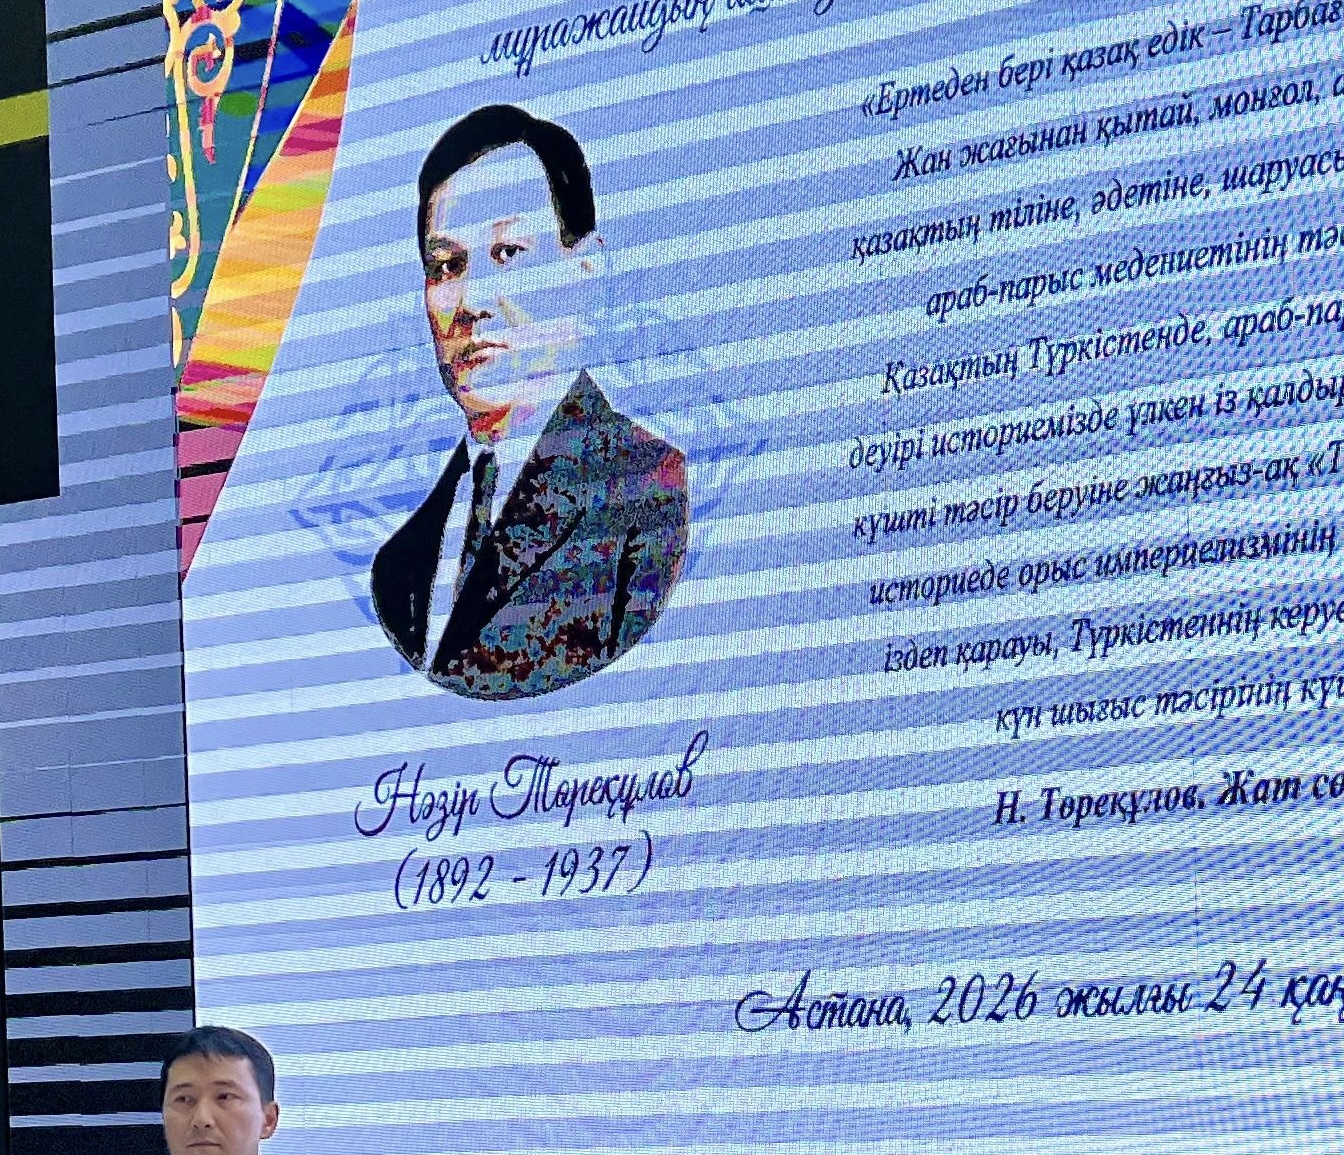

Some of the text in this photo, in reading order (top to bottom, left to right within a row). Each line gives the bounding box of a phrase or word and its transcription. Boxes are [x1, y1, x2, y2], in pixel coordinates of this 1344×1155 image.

[861, 66, 988, 119] «Ертеден
[999, 47, 1054, 92] бері
[1061, 39, 1140, 77] қазақ
[1148, 20, 1204, 58] едік
[891, 146, 951, 182] Жан
[959, 119, 1087, 168] жағынан
[1096, 92, 1199, 147] қытай,
[1210, 78, 1320, 121] монғол,
[851, 214, 980, 266] қазақтың
[989, 193, 1080, 231] тіліне,
[1092, 170, 1211, 217] әдетіне,
[925, 265, 1083, 323] араб-парыс
[1089, 230, 1287, 288] медениетінің
[882, 343, 1018, 396] Қазақтың
[1028, 314, 1212, 377] Түркістенде,
[848, 427, 924, 474] деуірі
[930, 398, 1118, 457] историемізде
[1127, 392, 1204, 436] үлкен
[1214, 382, 1238, 415] із
[853, 507, 936, 545] күшті
[944, 490, 1018, 530] тәсір
[1026, 474, 1129, 520] беруіне
[1134, 455, 1298, 500] жаңғыз-ақ
[869, 558, 1010, 607] историеде
[1018, 555, 1087, 593] орыс
[885, 640, 948, 674] іздеп
[956, 628, 1059, 672] қарауы,
[1069, 602, 1258, 660] Түркістеннің
[995, 703, 1042, 739] күн
[1051, 690, 1148, 729] шығыс
[1155, 672, 1291, 719] тәсірінің
[355, 730, 709, 842] Нәзір Төреқұлов
[994, 788, 1026, 825] Н.
[1215, 769, 1302, 807] Жат
[395, 847, 494, 910] (1892
[541, 830, 653, 897] 1937)
[735, 970, 912, 1032] Астана,
[929, 970, 1037, 1024] 2026
[1055, 974, 1194, 1018] жылғы
[1205, 958, 1266, 1013] 24
